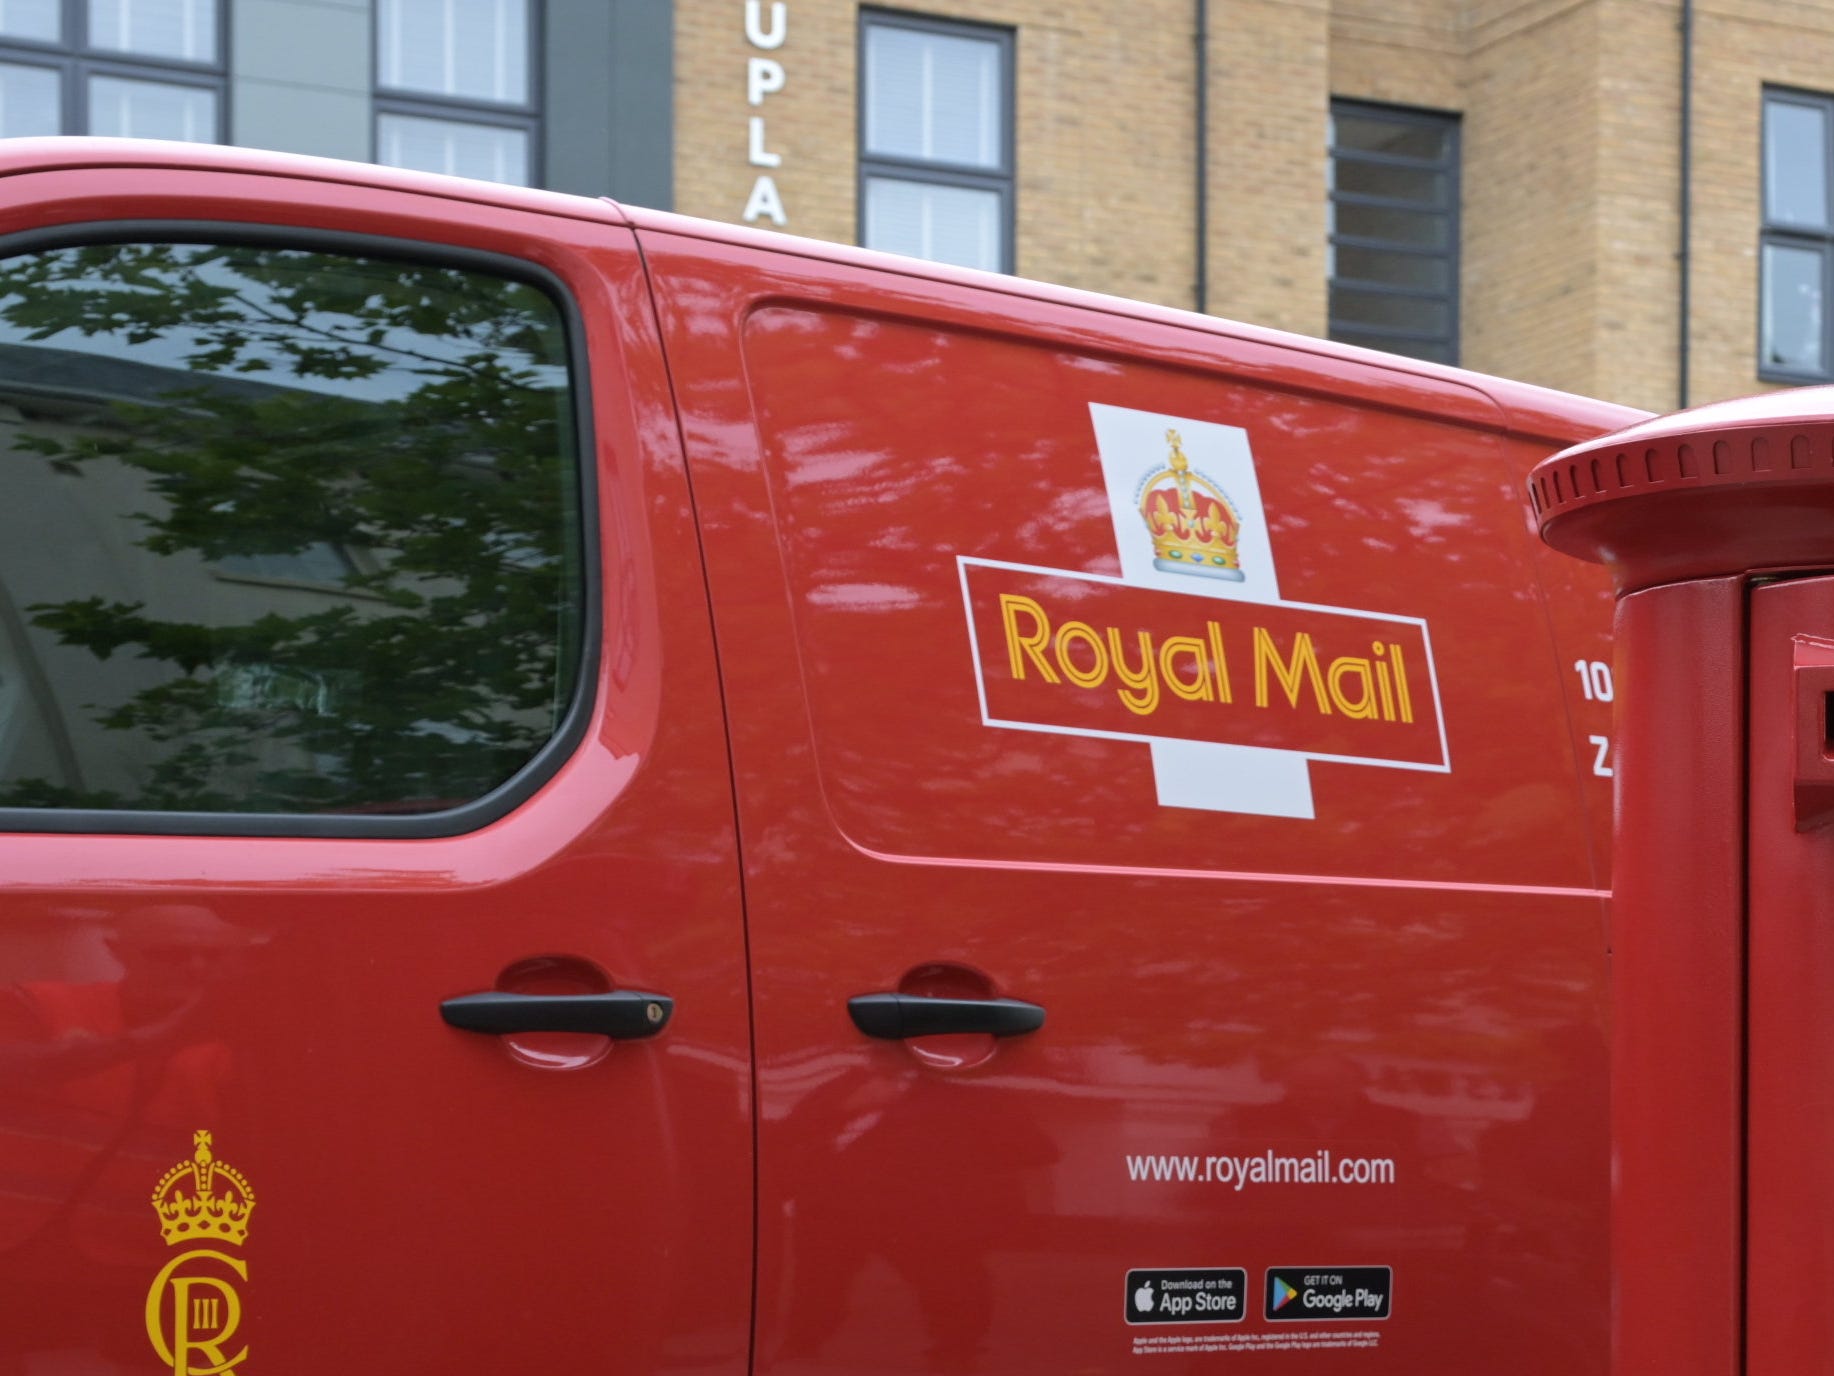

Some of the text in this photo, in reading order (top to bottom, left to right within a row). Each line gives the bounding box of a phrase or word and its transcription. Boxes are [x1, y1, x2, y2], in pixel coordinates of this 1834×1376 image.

[999, 593, 1414, 723] Royal Mail
[1126, 1150, 1395, 1191] www.royalmail.com
[1161, 1278, 1233, 1290] Download on the
[1304, 1275, 1343, 1285] GET IT ON
[1160, 1291, 1237, 1315] App Store
[1303, 1288, 1384, 1312] Google Play
